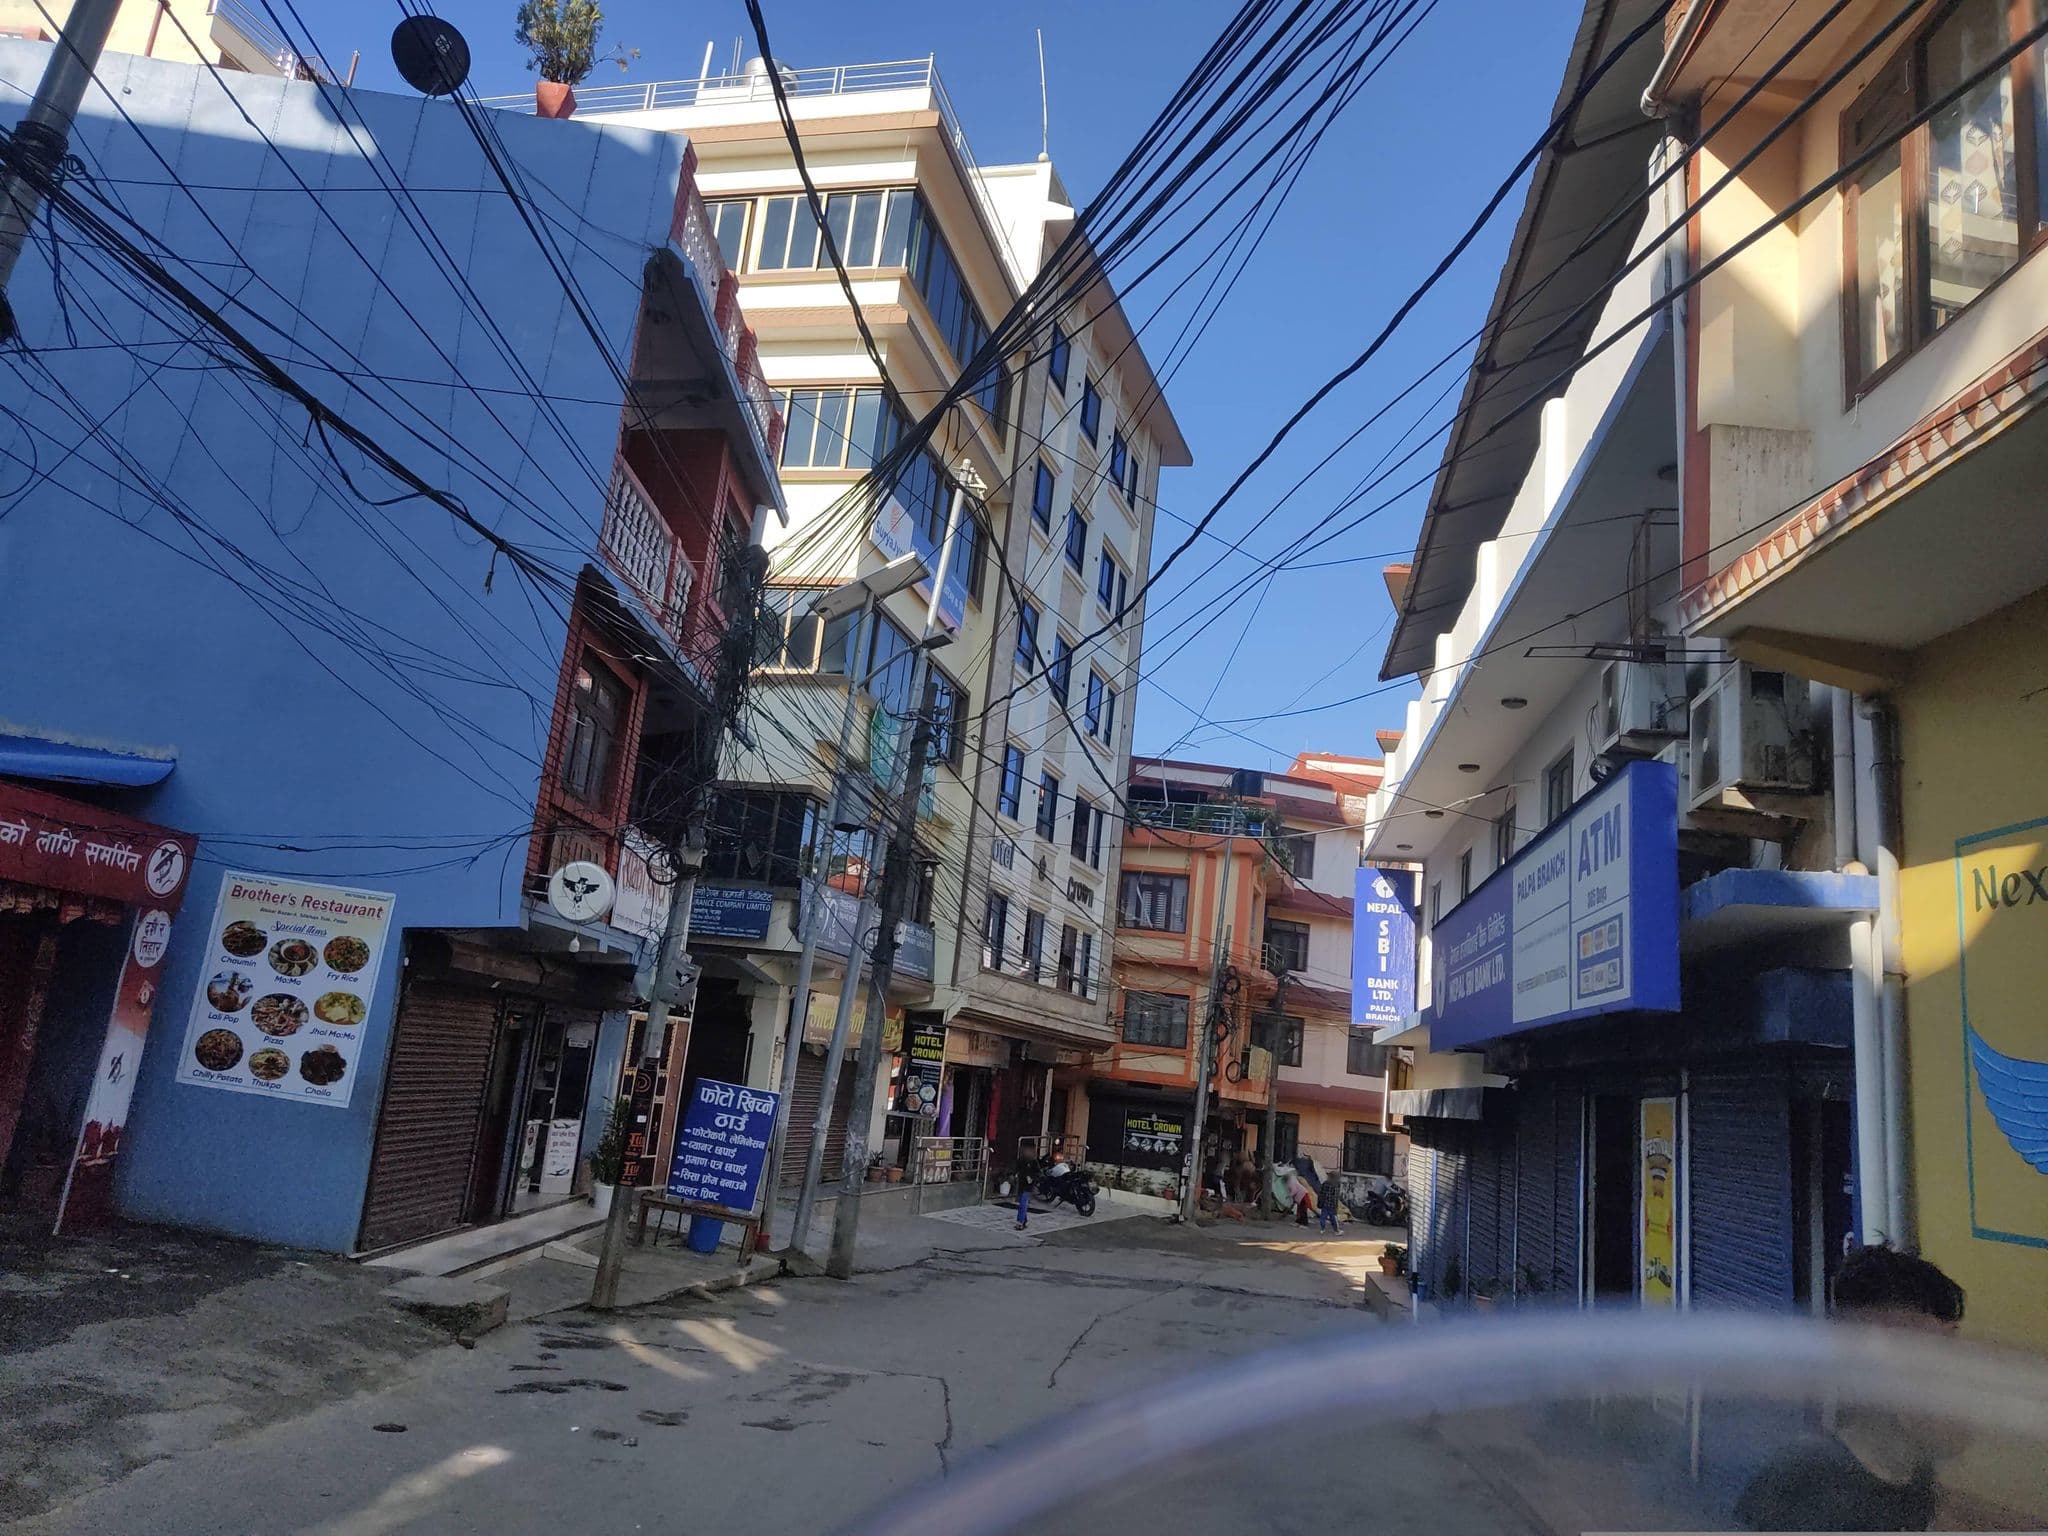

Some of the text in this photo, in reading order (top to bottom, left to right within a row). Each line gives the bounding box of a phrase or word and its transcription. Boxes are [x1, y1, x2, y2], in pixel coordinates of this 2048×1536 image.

[1578, 803, 1622, 882] ATM
[36, 828, 81, 858] लागि
[84, 841, 142, 873] समर्पित
[1517, 848, 1566, 904] PALPA BRANCH
[230, 885, 297, 906] Brother's
[300, 895, 385, 919] Restaurant
[1366, 902, 1402, 914] NEPAL
[326, 972, 359, 983] Fry Rice
[1367, 977, 1399, 989] BANK
[1372, 990, 1394, 1001] LTD.
[1370, 1004, 1396, 1013] PALPA
[1366, 1012, 1400, 1022] BRANCH
[263, 1035, 284, 1046] Pizza
[914, 1034, 943, 1047] HOTEL
[911, 1047, 943, 1060] CROWN
[192, 1068, 215, 1081] Chilly
[700, 1085, 777, 1116] फोटो खिच्ने
[714, 1113, 750, 1132] ठाउँ
[1127, 1118, 1182, 1134] HOTEL CROWN
[714, 1146, 738, 1159] छपाई
[724, 1162, 748, 1177] छपाई
[676, 1184, 699, 1197] कलर
